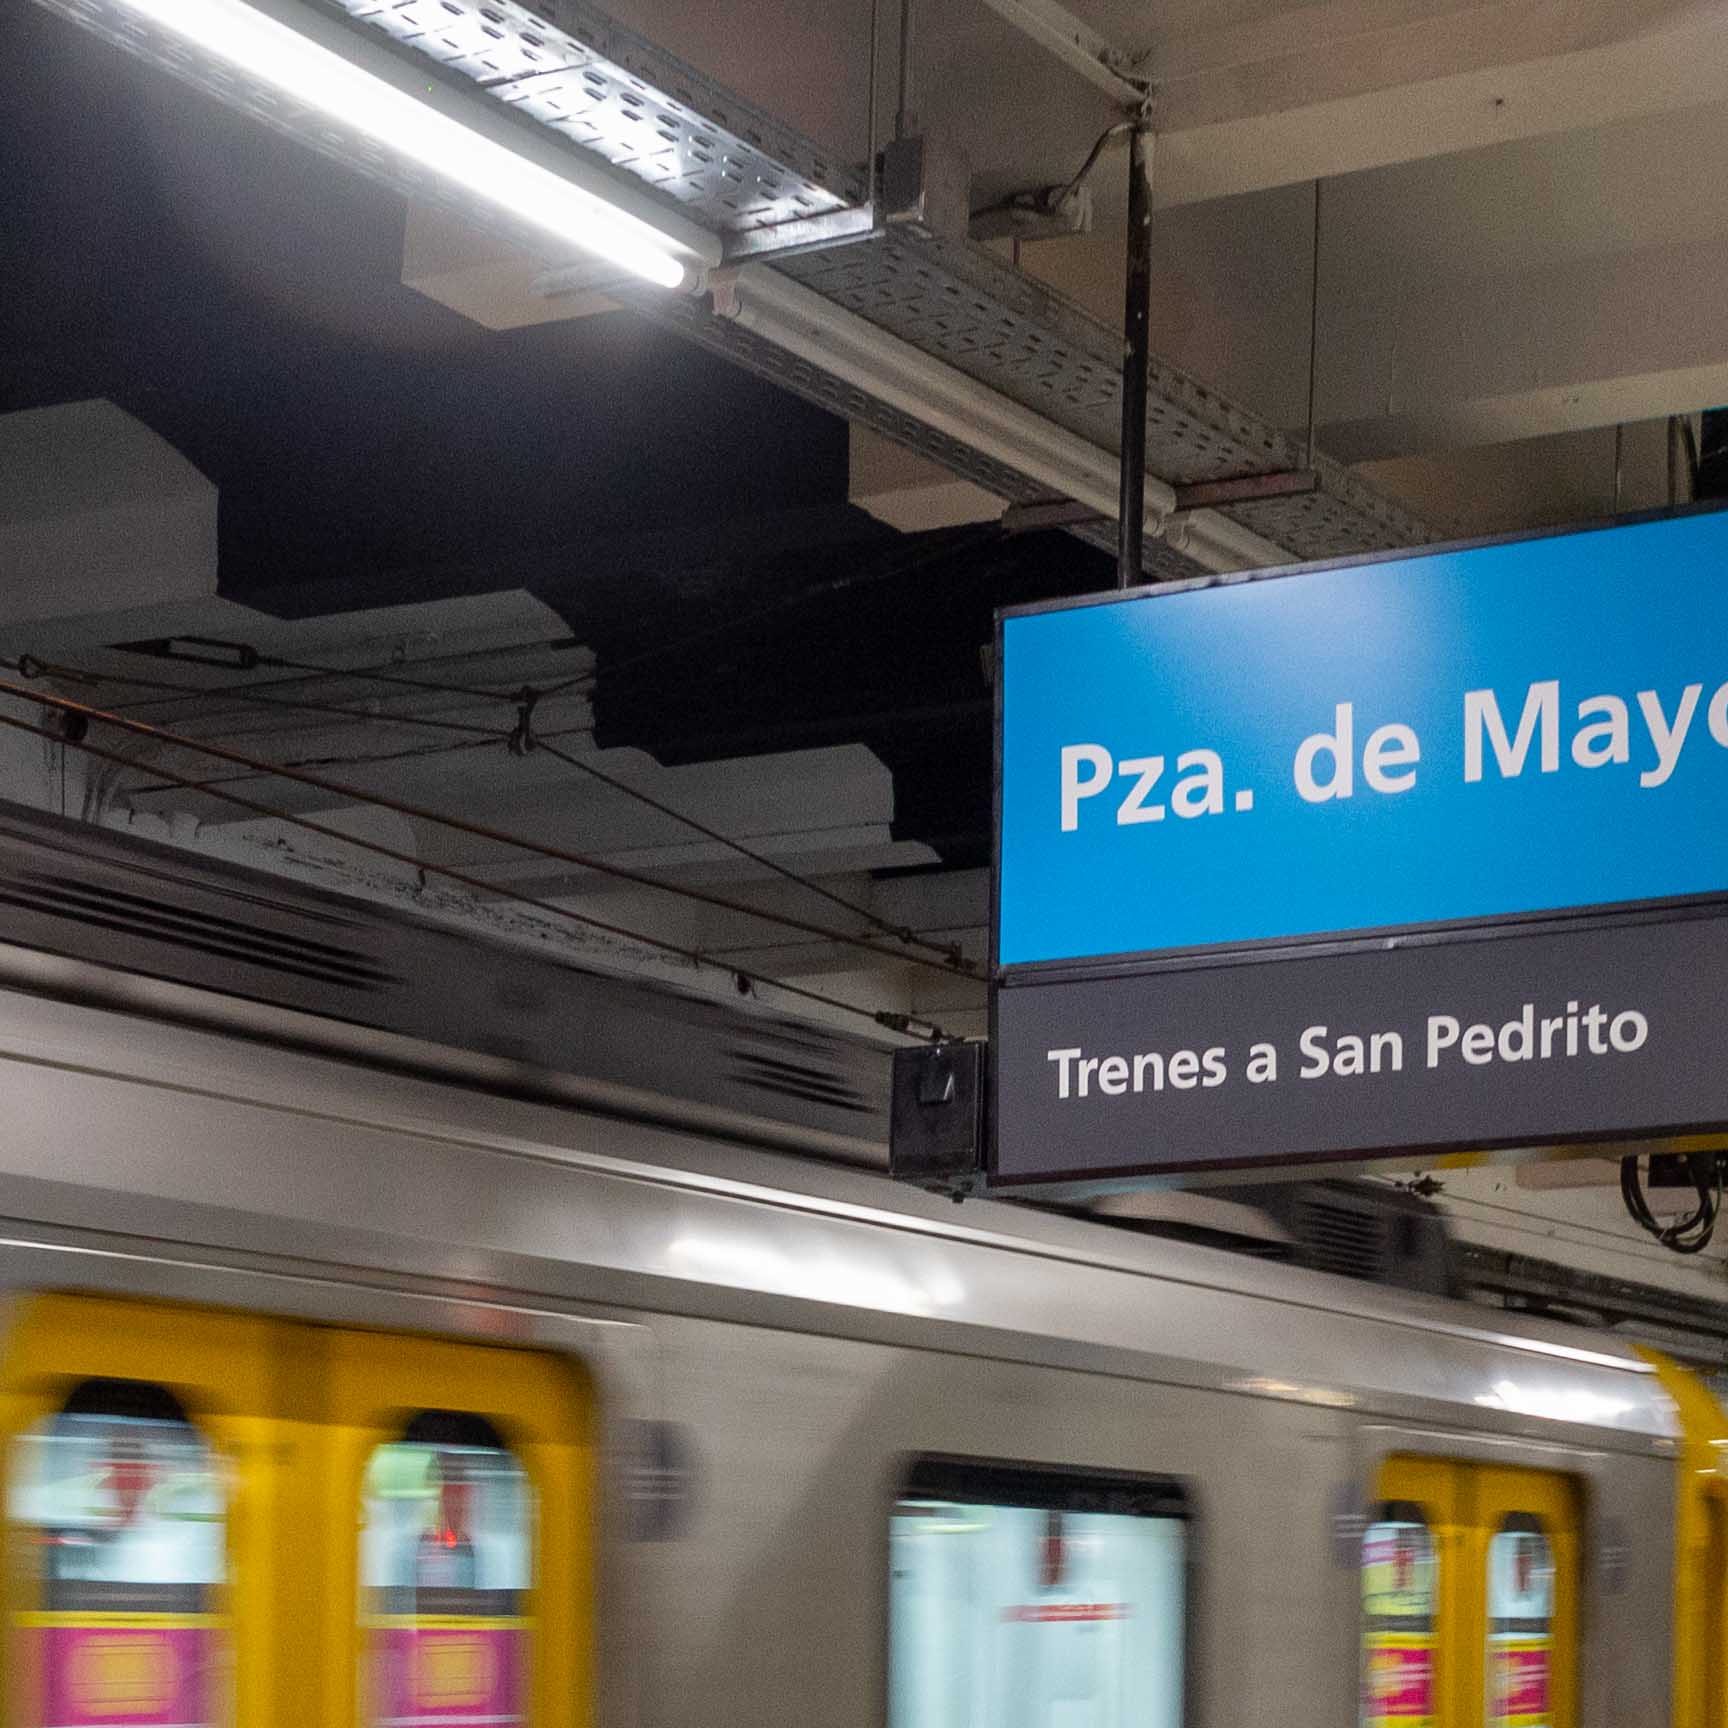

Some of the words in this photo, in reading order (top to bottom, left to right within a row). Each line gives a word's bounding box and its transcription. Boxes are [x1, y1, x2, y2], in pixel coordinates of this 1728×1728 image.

[1059, 743, 1254, 833] Pza.
[1292, 702, 1420, 803] de
[1047, 1046, 1227, 1099] Trenes
[1244, 1041, 1277, 1083] a
[1299, 1024, 1403, 1080] San
[1426, 1000, 1650, 1069] Pedrito
